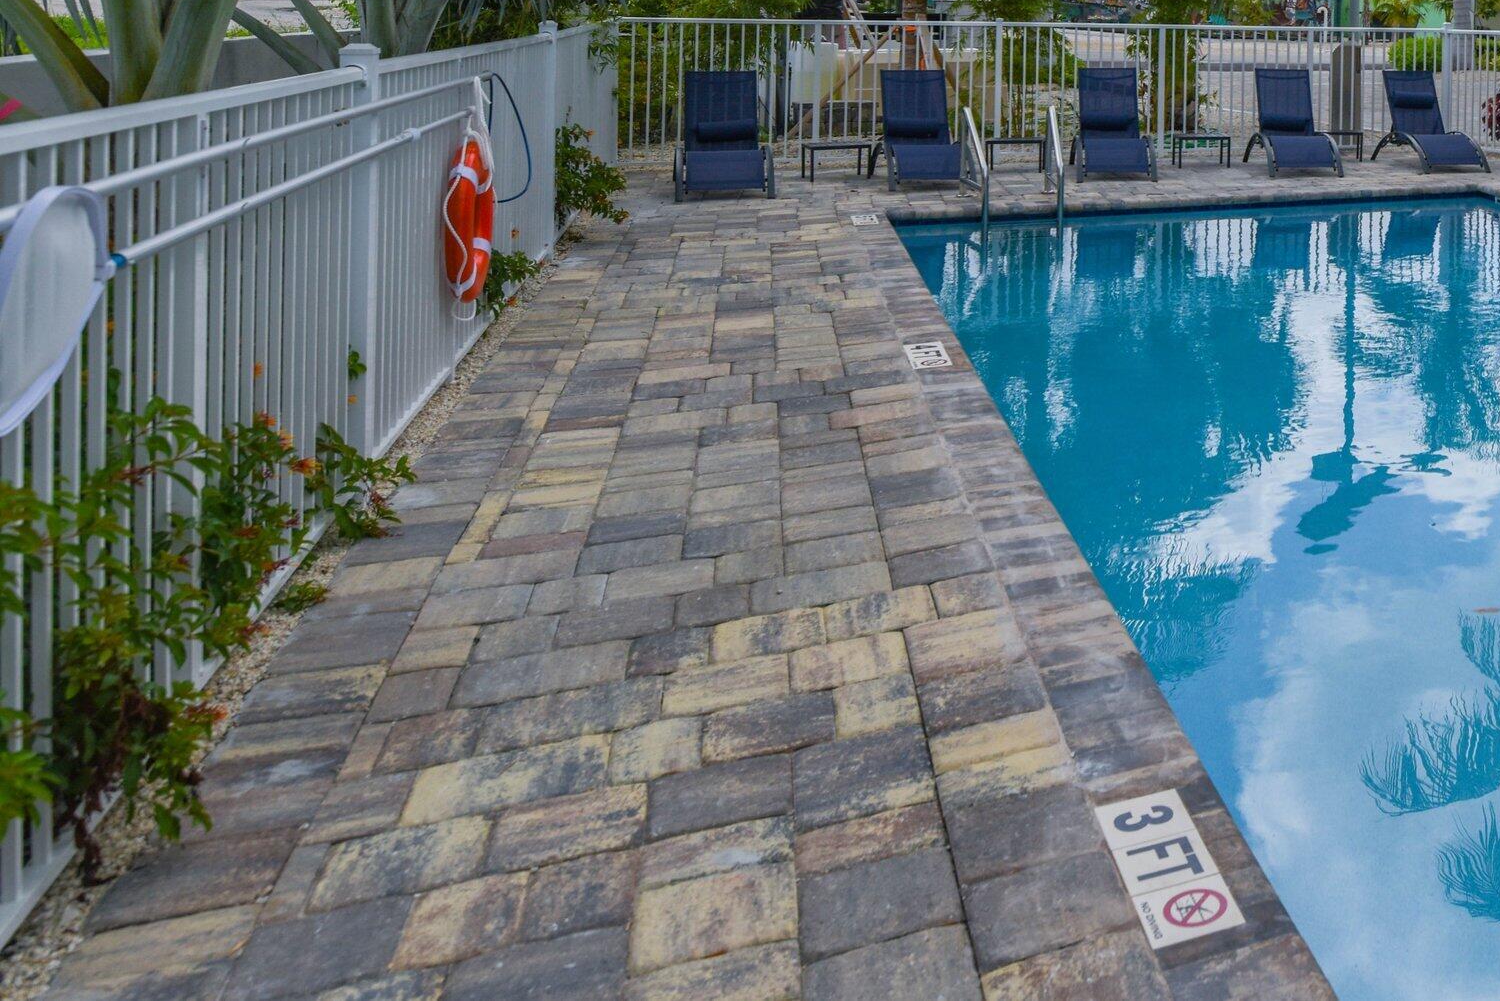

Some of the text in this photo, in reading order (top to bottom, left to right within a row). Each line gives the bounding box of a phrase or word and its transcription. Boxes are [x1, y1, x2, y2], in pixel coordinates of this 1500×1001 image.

[1113, 805, 1205, 882] 3 FT
[1139, 901, 1164, 940] NO DIVING
